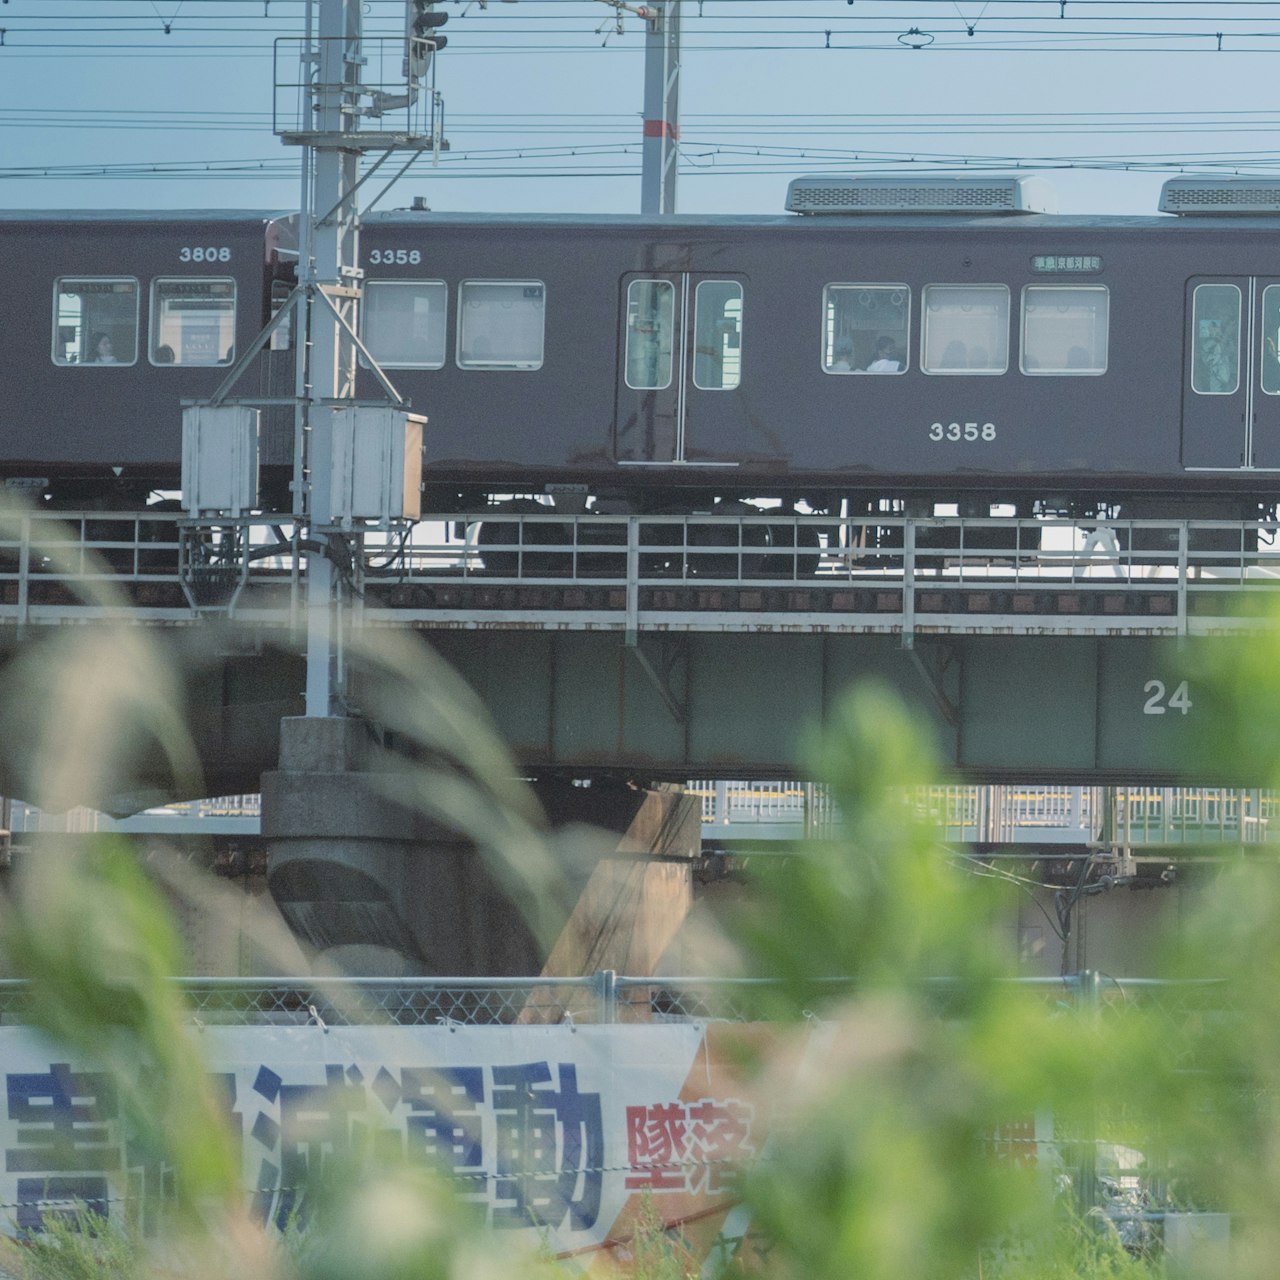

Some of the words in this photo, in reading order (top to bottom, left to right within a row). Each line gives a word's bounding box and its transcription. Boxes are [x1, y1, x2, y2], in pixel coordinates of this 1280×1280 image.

[179, 247, 231, 262] 3808
[369, 249, 421, 264] 3358
[929, 422, 997, 441] 3358
[1143, 679, 1193, 715] 24
